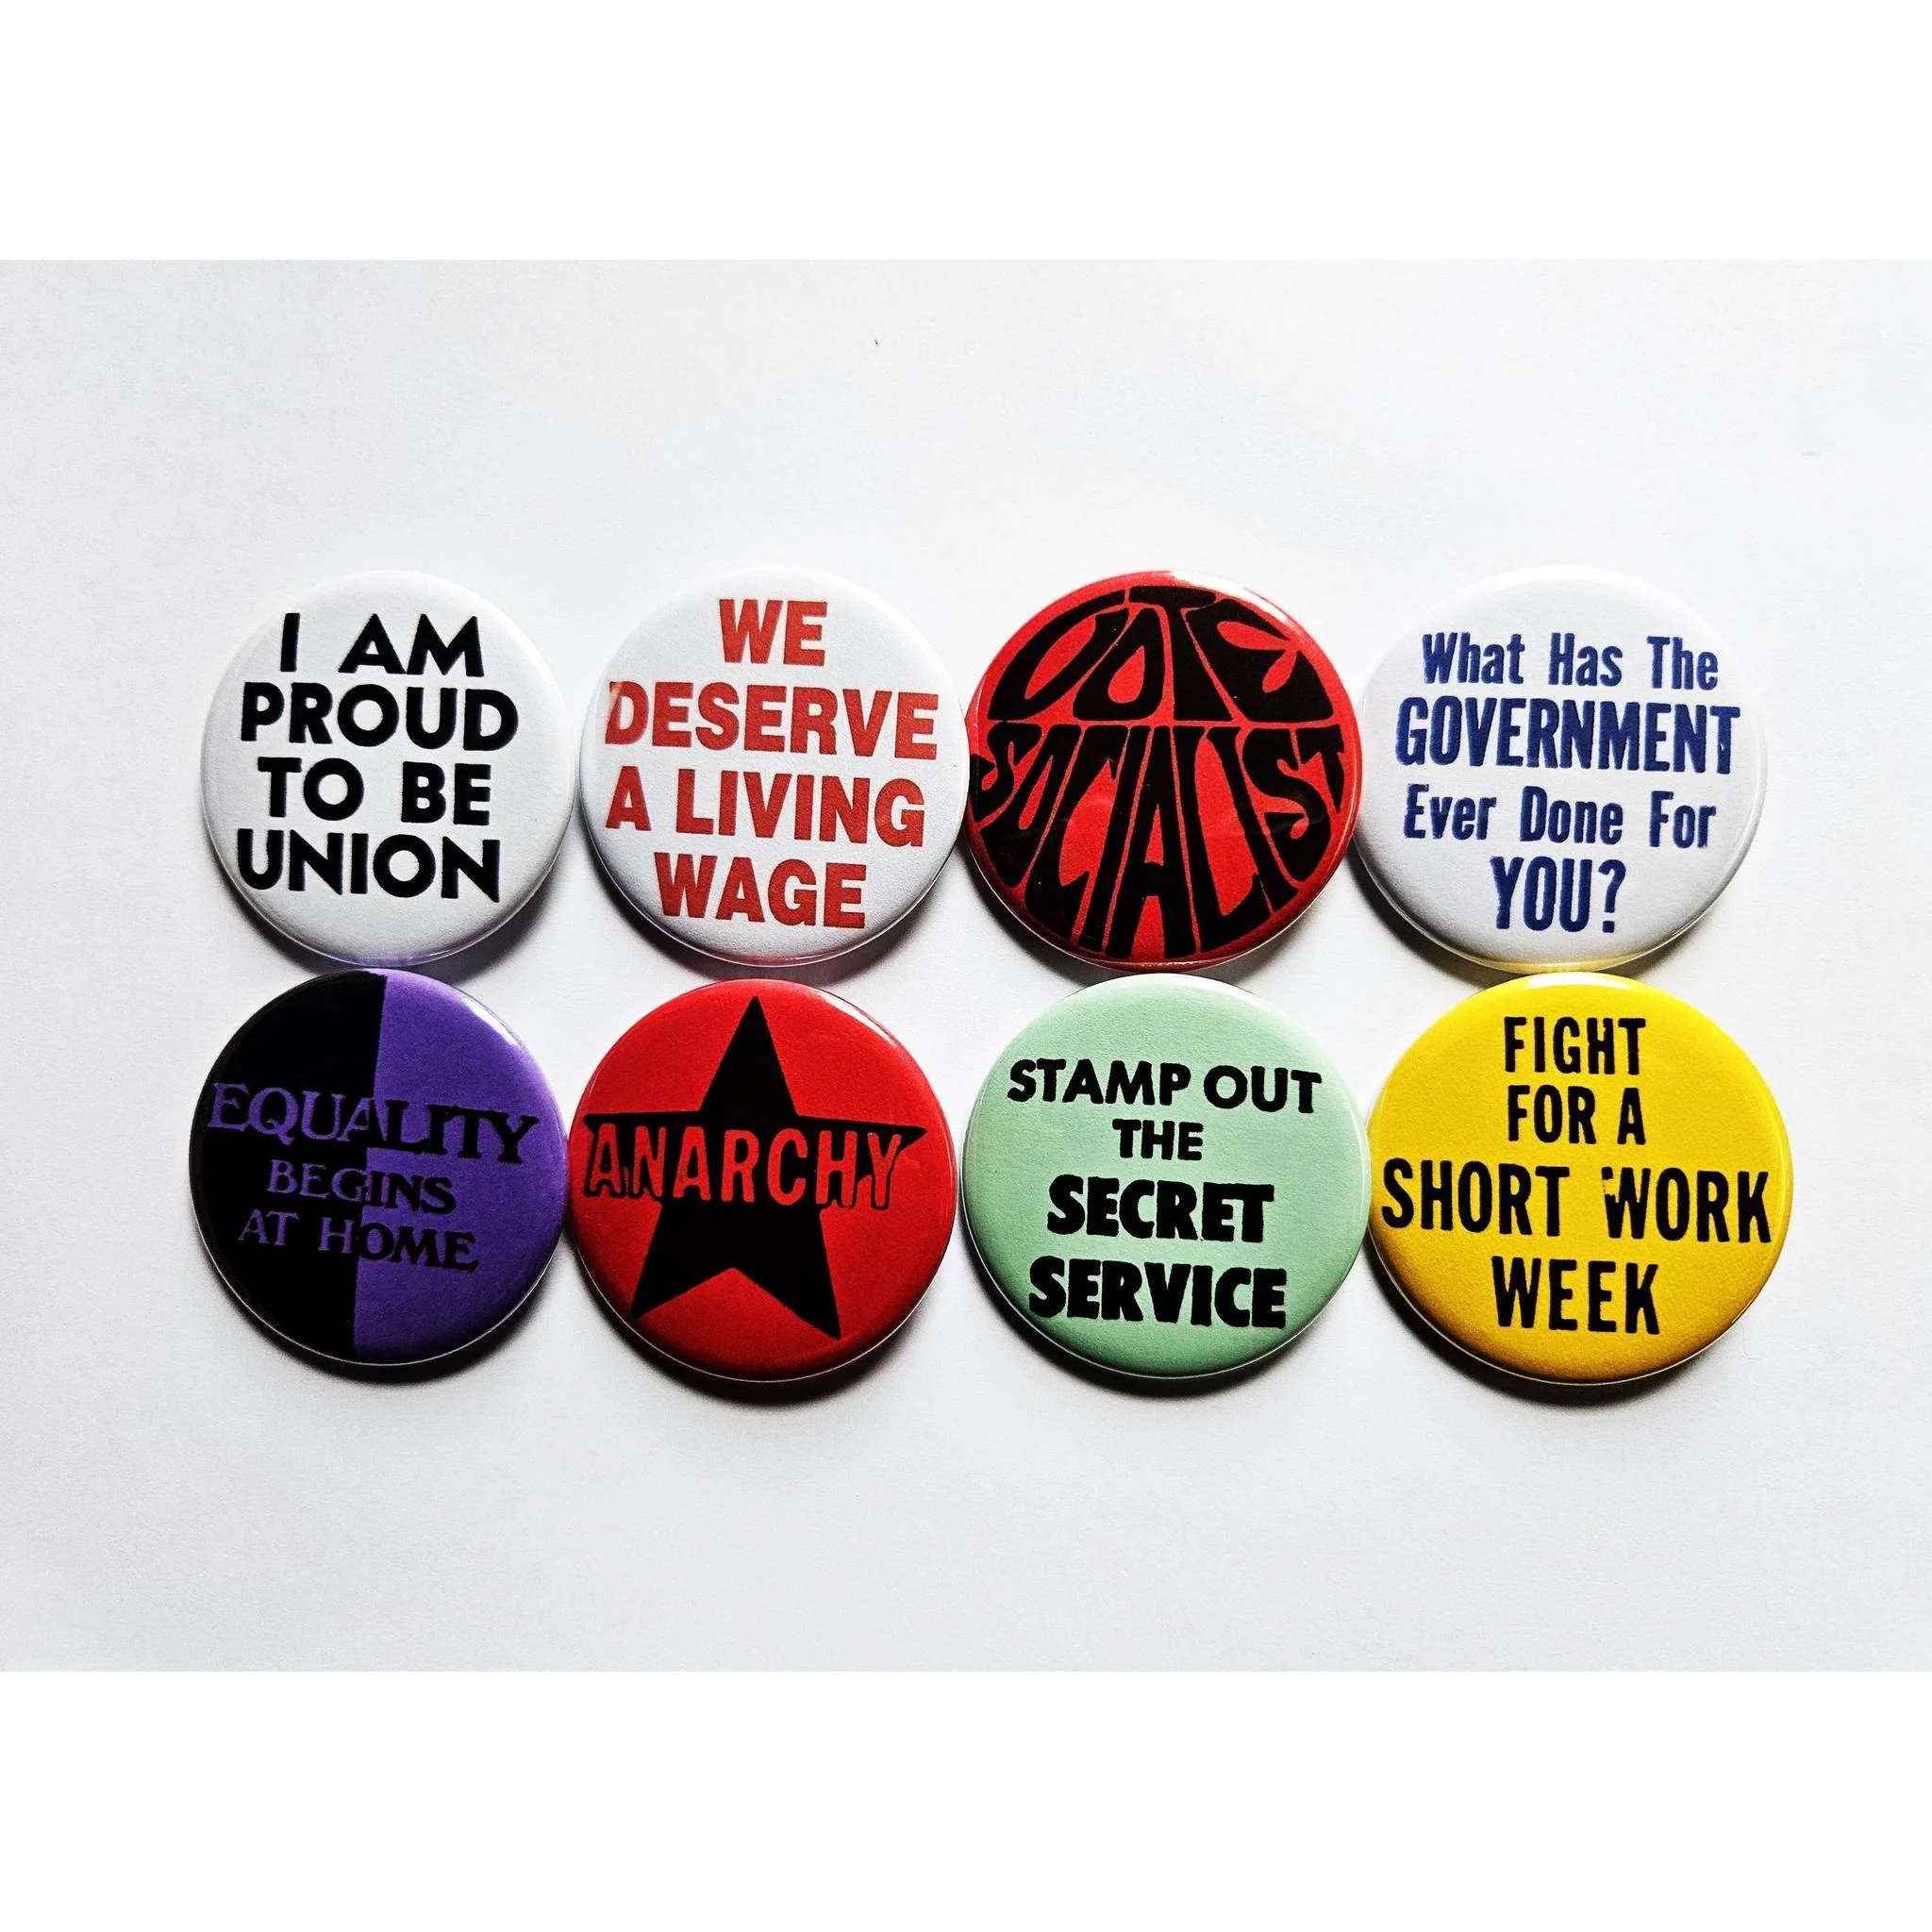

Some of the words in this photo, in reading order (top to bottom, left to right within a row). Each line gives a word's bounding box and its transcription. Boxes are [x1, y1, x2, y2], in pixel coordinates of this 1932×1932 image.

[280, 612, 300, 672] I
[340, 613, 486, 677] AM
[718, 598, 827, 666] WE
[1422, 632, 1524, 687] What
[1549, 633, 1622, 688] Has
[1648, 635, 1719, 691] The
[240, 681, 520, 752] PROUD
[605, 681, 939, 758] DESERVE
[1394, 697, 1740, 774] GOVERNMENT
[258, 756, 364, 822] TO
[401, 760, 491, 825] BE
[605, 764, 652, 831] A
[675, 770, 925, 847] LIVING
[1404, 784, 1496, 841] Ever
[1521, 787, 1624, 845] Done
[1649, 791, 1717, 849] For
[238, 829, 501, 903] UNION
[969, 721, 1346, 959] SOCIALIST
[653, 851, 867, 929] WAGE
[1490, 857, 1626, 934] YOU?
[1504, 1016, 1647, 1075] FIGHT
[1008, 1058, 1192, 1107] STAMP
[1204, 1065, 1323, 1115] OUT
[1507, 1084, 1594, 1144] FOR
[1617, 1086, 1646, 1145] A
[208, 1082, 541, 1166] EQUALITY
[1112, 1119, 1204, 1161] THE
[267, 1159, 457, 1213] BEGINS
[583, 1122, 908, 1209] ANARCHY
[1380, 1158, 1571, 1237] SHORT
[1602, 1167, 1772, 1244] WORK
[238, 1210, 299, 1249] AT
[318, 1217, 479, 1273] HOME
[1047, 1174, 1274, 1243] SECRET
[1028, 1255, 1287, 1329] SERVICE
[1491, 1255, 1660, 1335] WEEK
